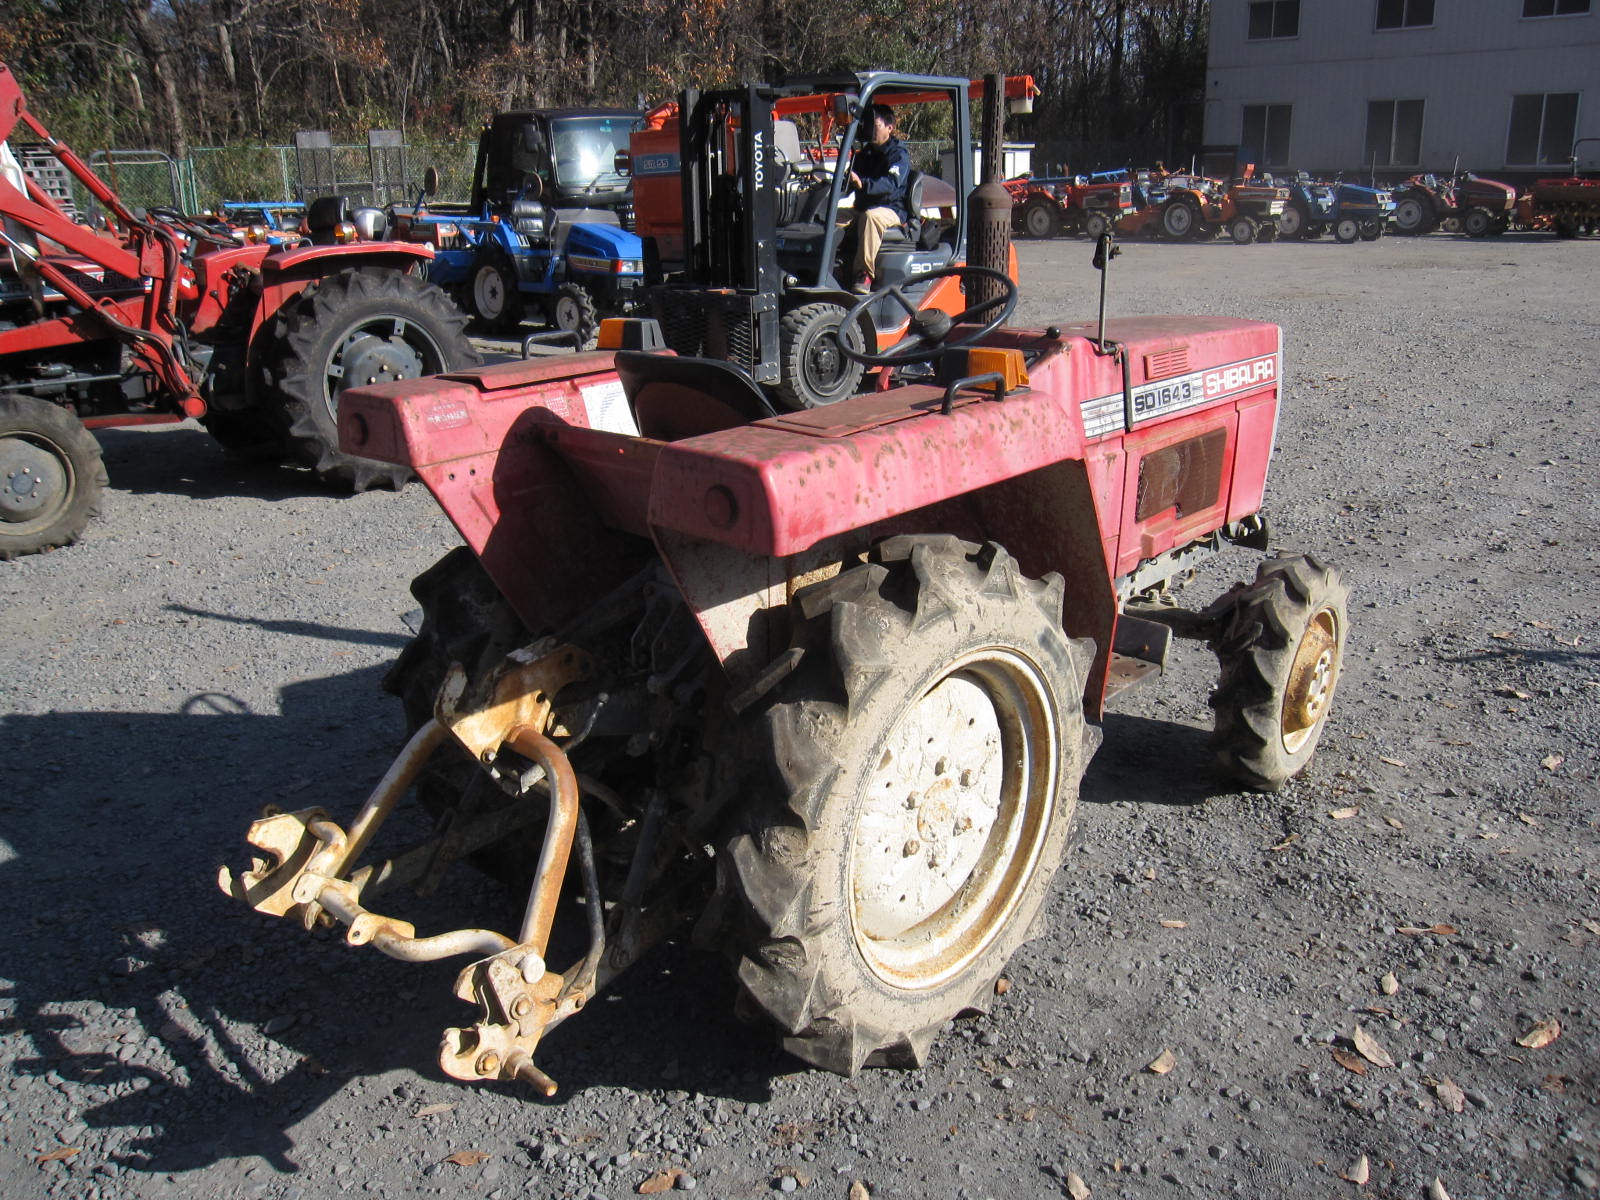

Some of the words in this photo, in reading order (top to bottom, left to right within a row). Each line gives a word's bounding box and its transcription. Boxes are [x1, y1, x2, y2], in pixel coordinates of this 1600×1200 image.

[754, 131, 764, 192] TOYOTA
[911, 262, 932, 274] 30
[1134, 382, 1191, 413] SD1643
[1206, 358, 1273, 395] SHIBAURA
